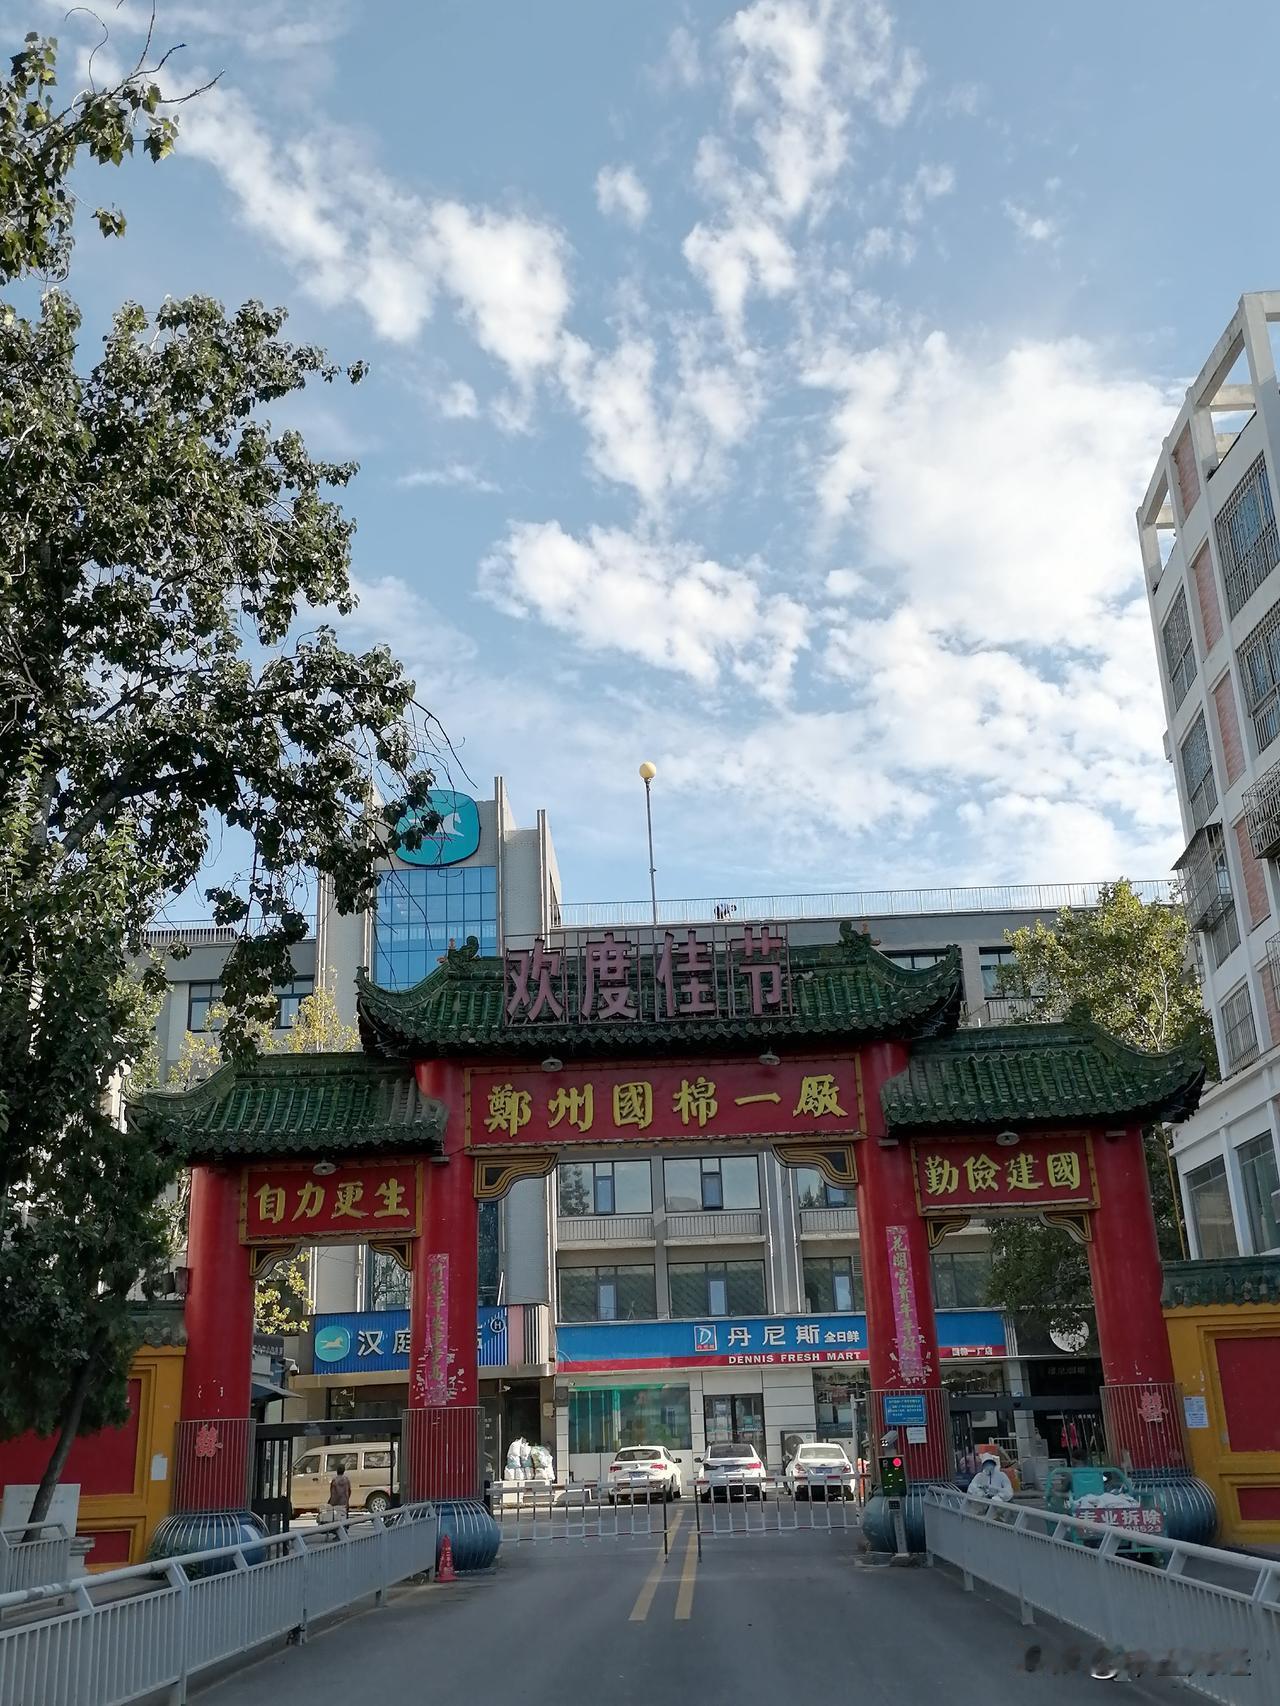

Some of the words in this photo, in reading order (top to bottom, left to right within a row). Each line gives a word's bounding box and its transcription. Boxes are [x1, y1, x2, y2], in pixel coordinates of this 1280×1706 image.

[506, 926, 785, 1021] 欢度佳节
[253, 1178, 411, 1224] 自力更生
[727, 1324, 820, 1347] 丹尼斯
[728, 1354, 774, 1364] DENNIS
[780, 1353, 820, 1362] FRESH
[827, 1352, 861, 1361] MART
